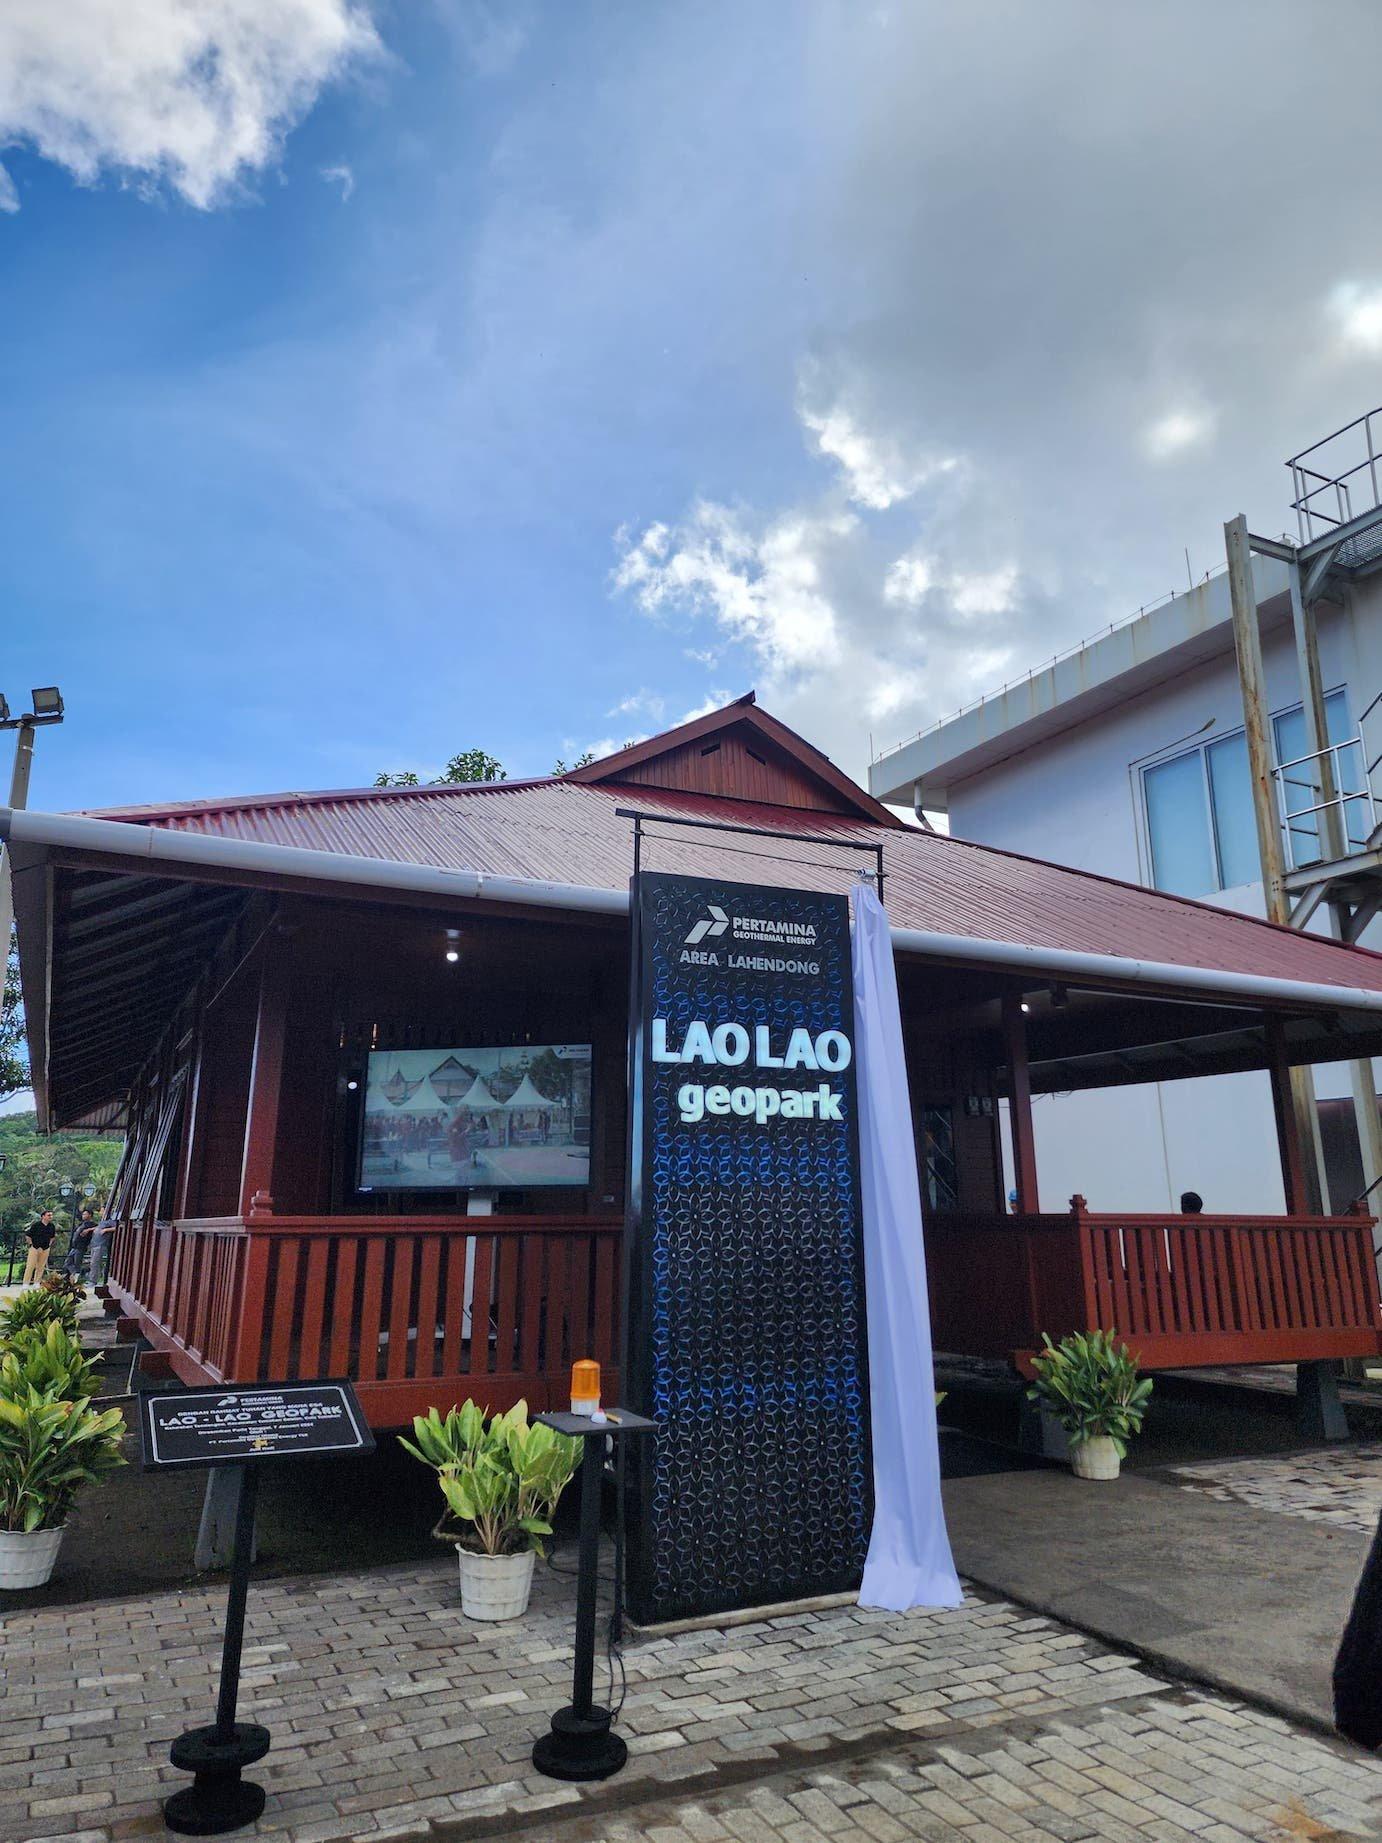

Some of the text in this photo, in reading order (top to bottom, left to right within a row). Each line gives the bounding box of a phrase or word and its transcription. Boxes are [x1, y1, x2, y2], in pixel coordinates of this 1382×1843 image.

[732, 916, 817, 937] PERTAMINA
[732, 930, 817, 946] GEOTHERMAL ENERGY
[680, 949, 820, 975] AREA LAHENDONG
[677, 1083, 844, 1124] geopark
[159, 1416, 197, 1427] LAO
[215, 1412, 252, 1423] LAO
[261, 1405, 342, 1419] GEOPARK
